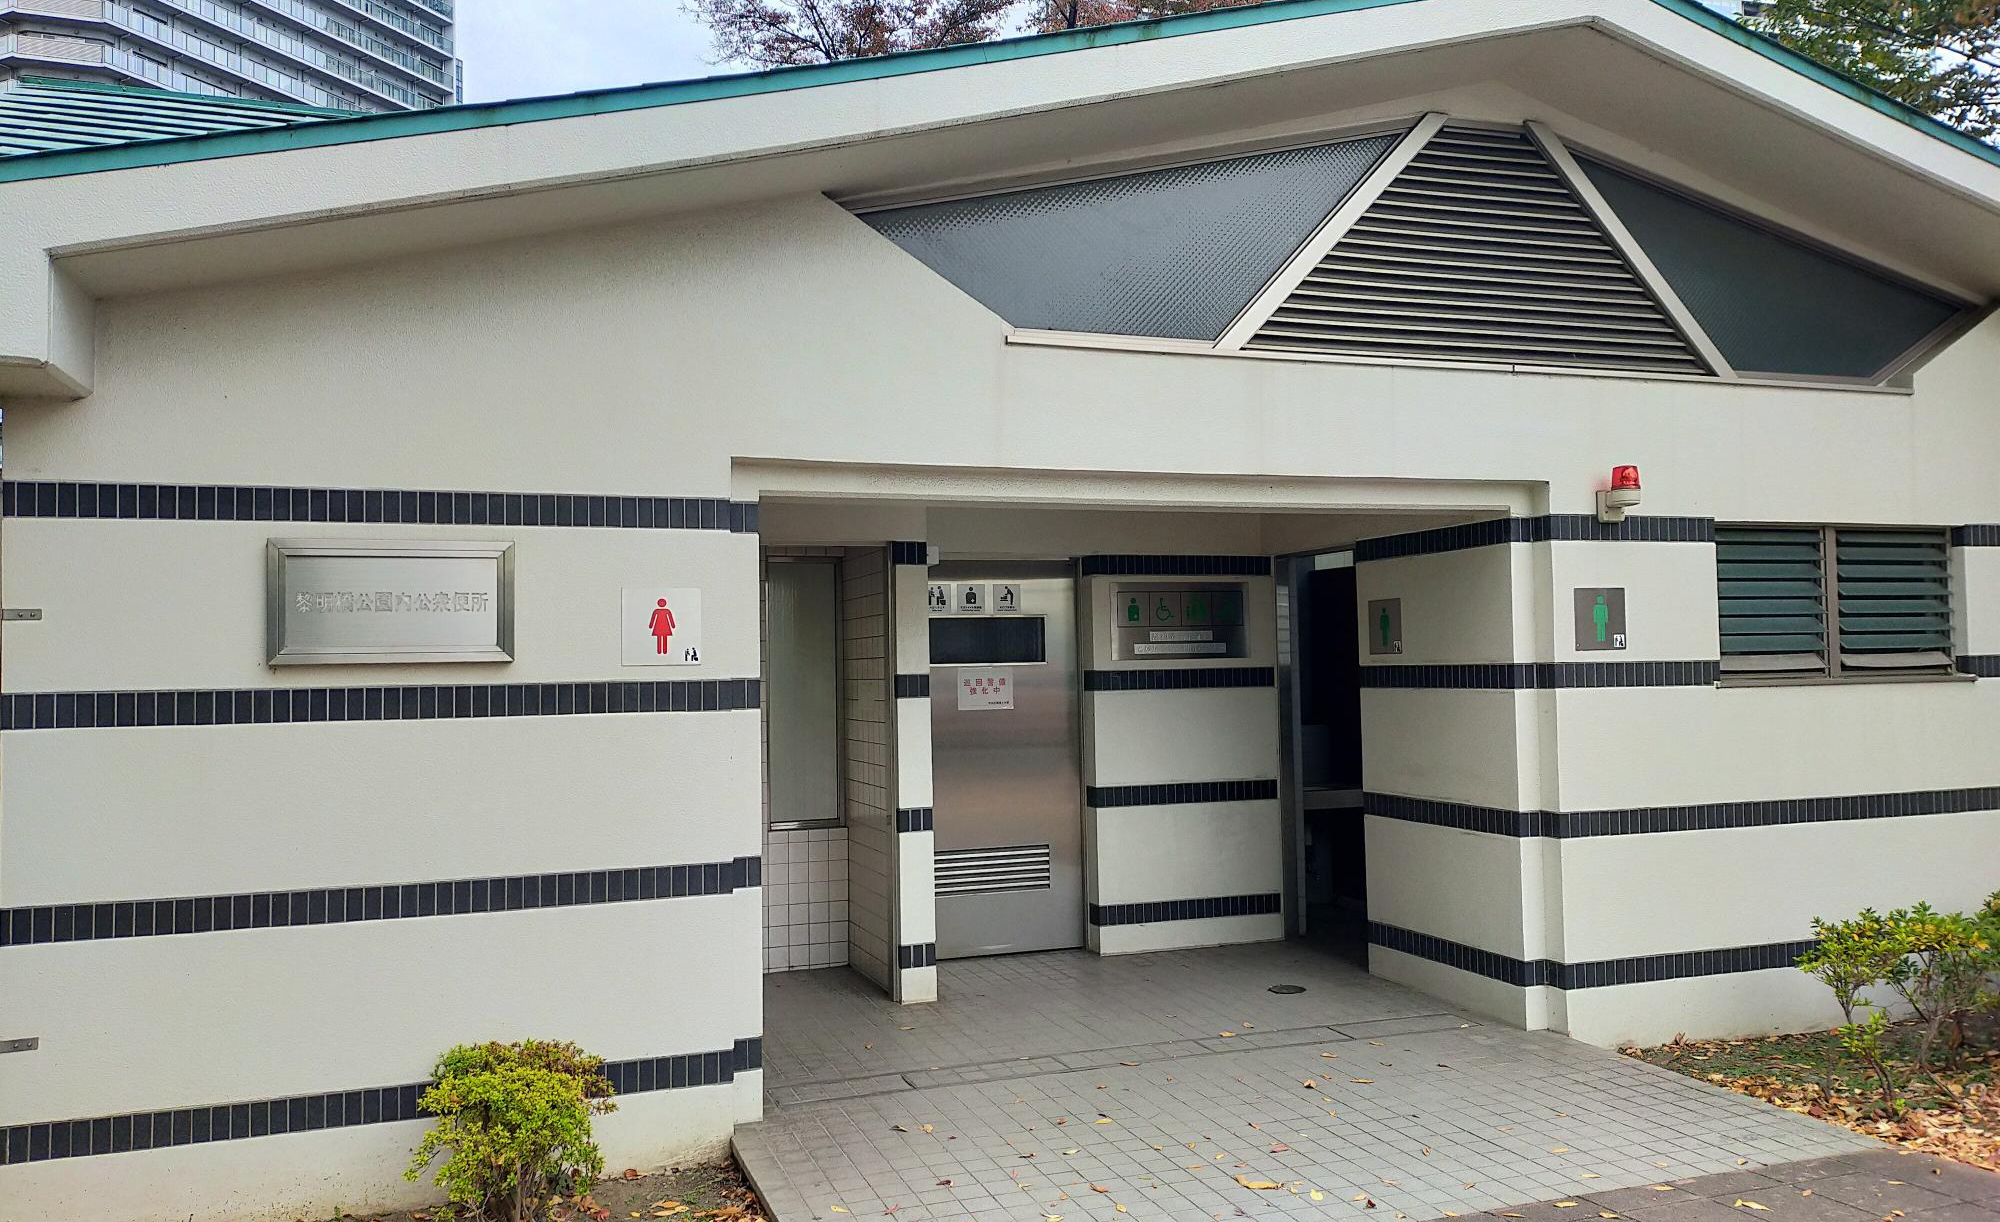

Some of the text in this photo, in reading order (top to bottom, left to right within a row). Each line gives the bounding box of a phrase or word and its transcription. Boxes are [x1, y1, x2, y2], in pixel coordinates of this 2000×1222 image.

[295, 590, 489, 614] 黎明橋公園内公衆便所
